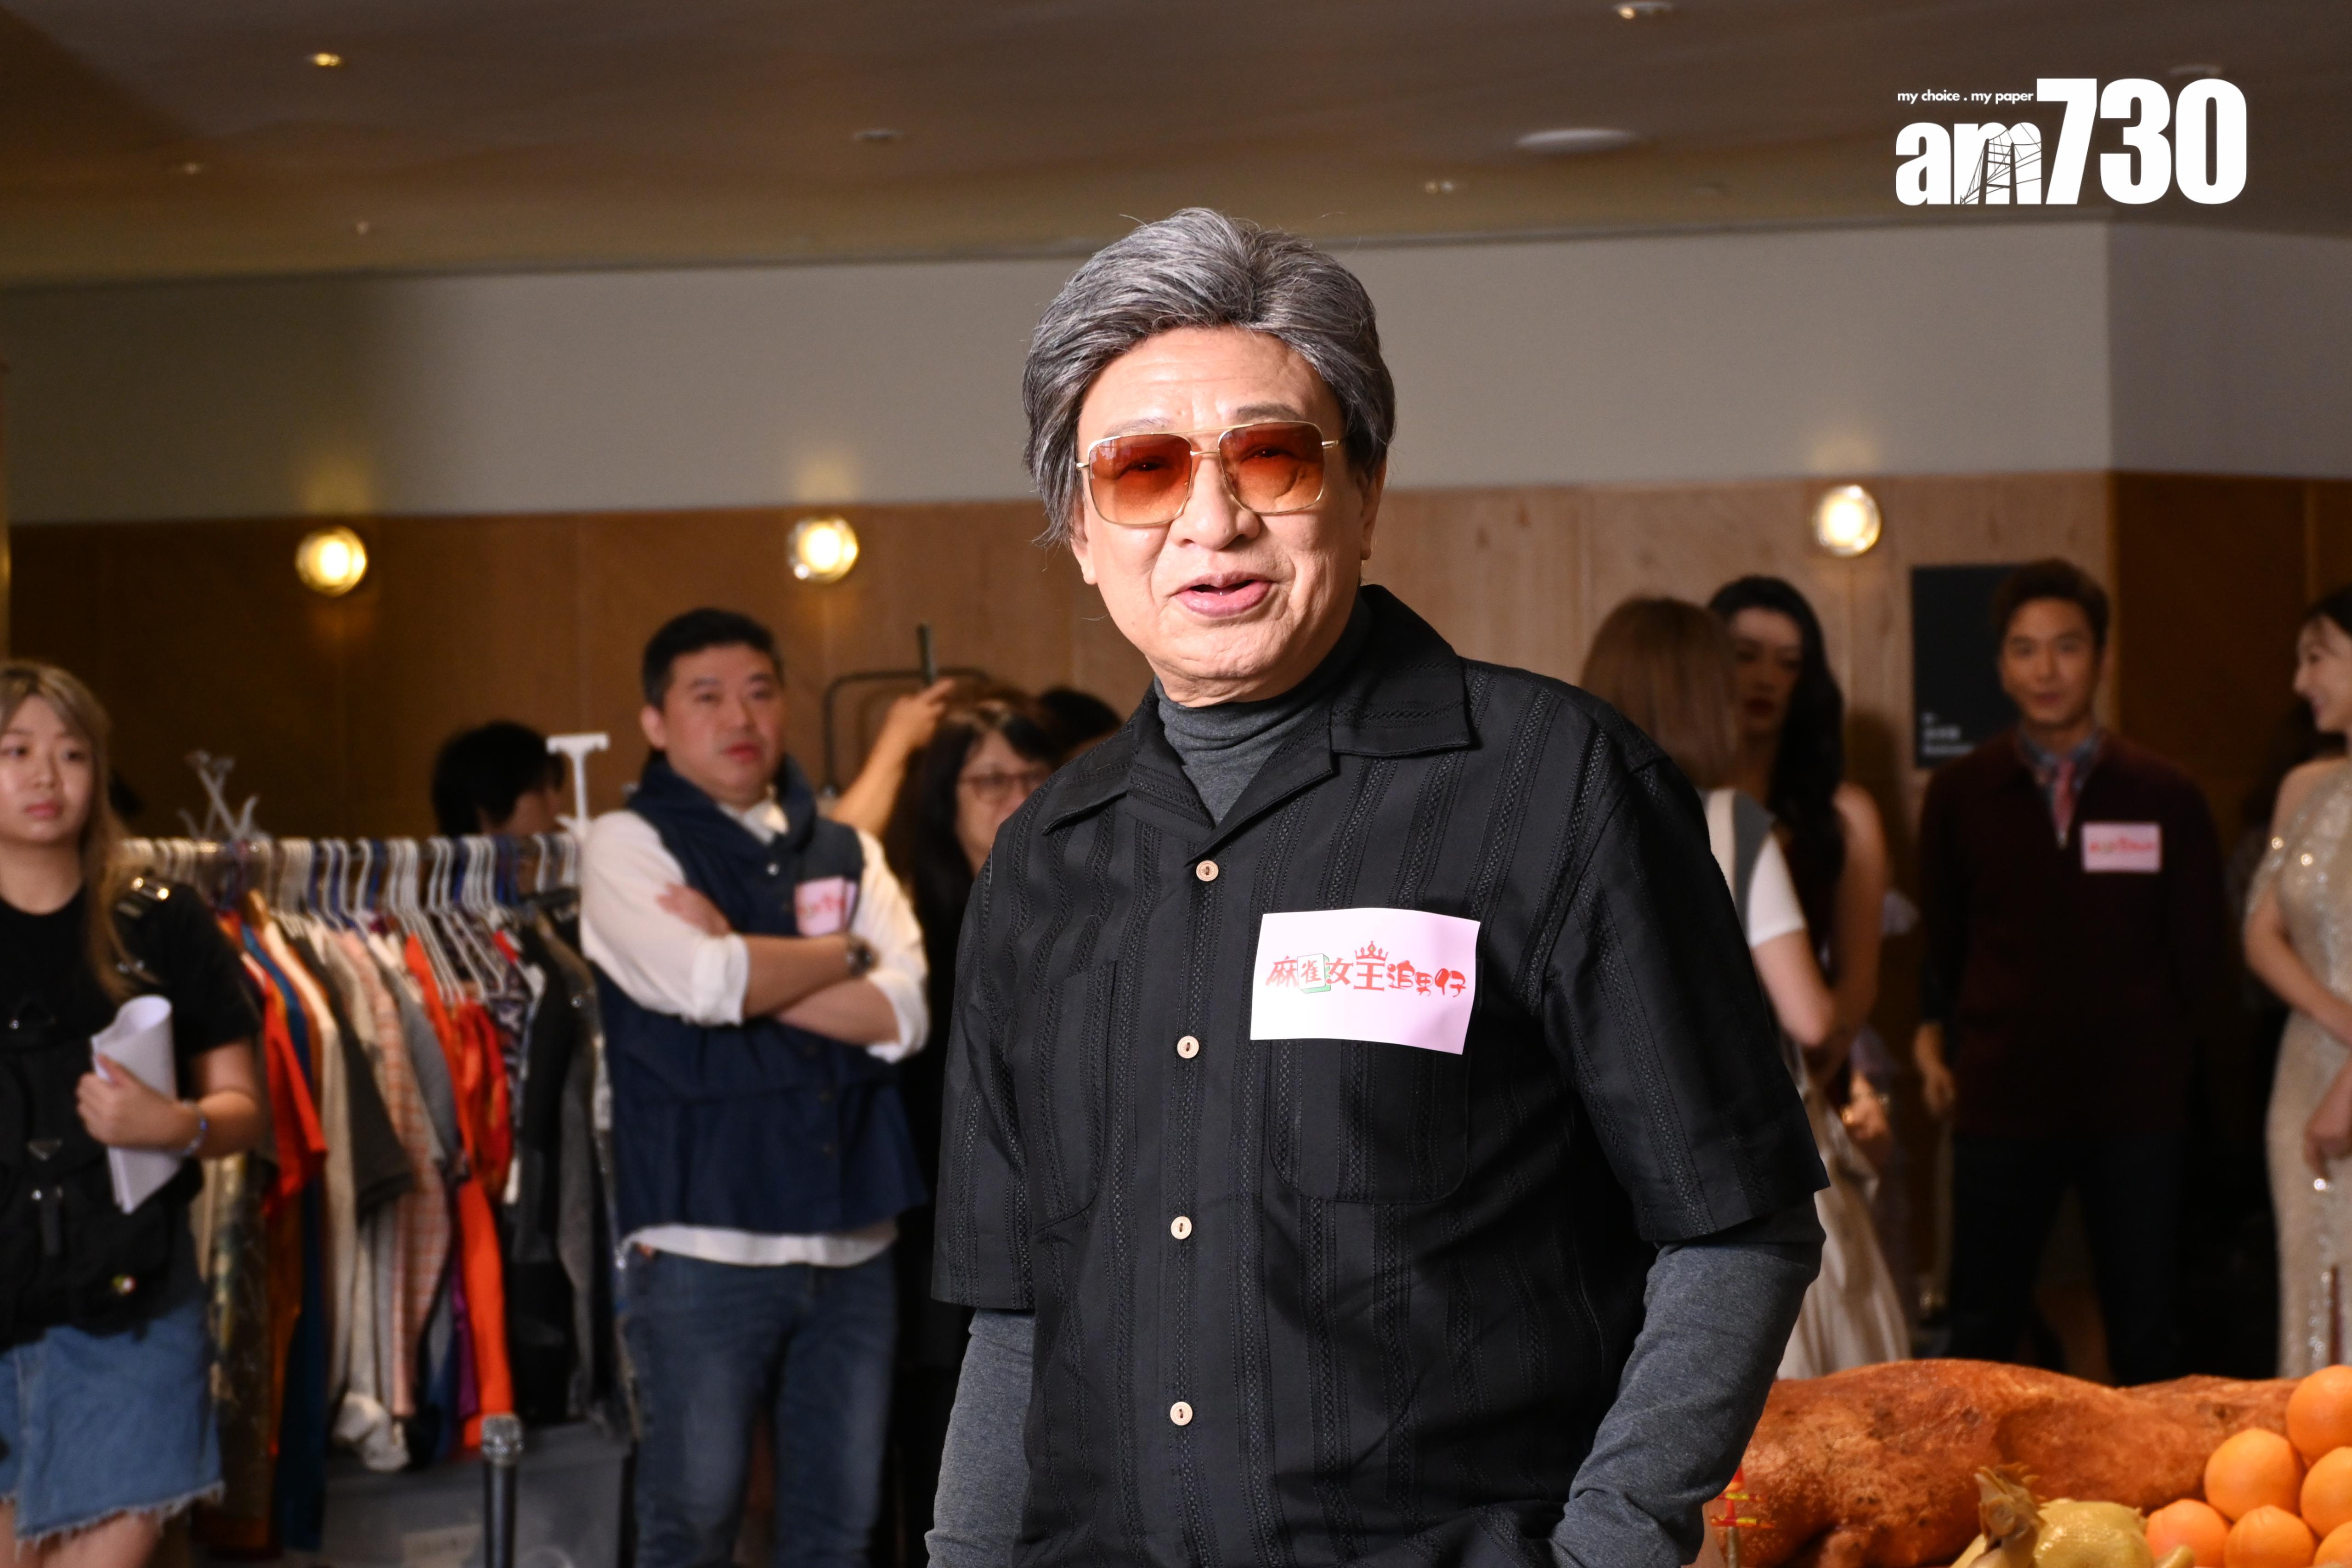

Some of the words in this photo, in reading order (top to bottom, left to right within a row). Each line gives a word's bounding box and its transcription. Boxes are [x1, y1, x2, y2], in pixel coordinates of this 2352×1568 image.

[1265, 955, 1466, 997] 麻雀女王追男仔
